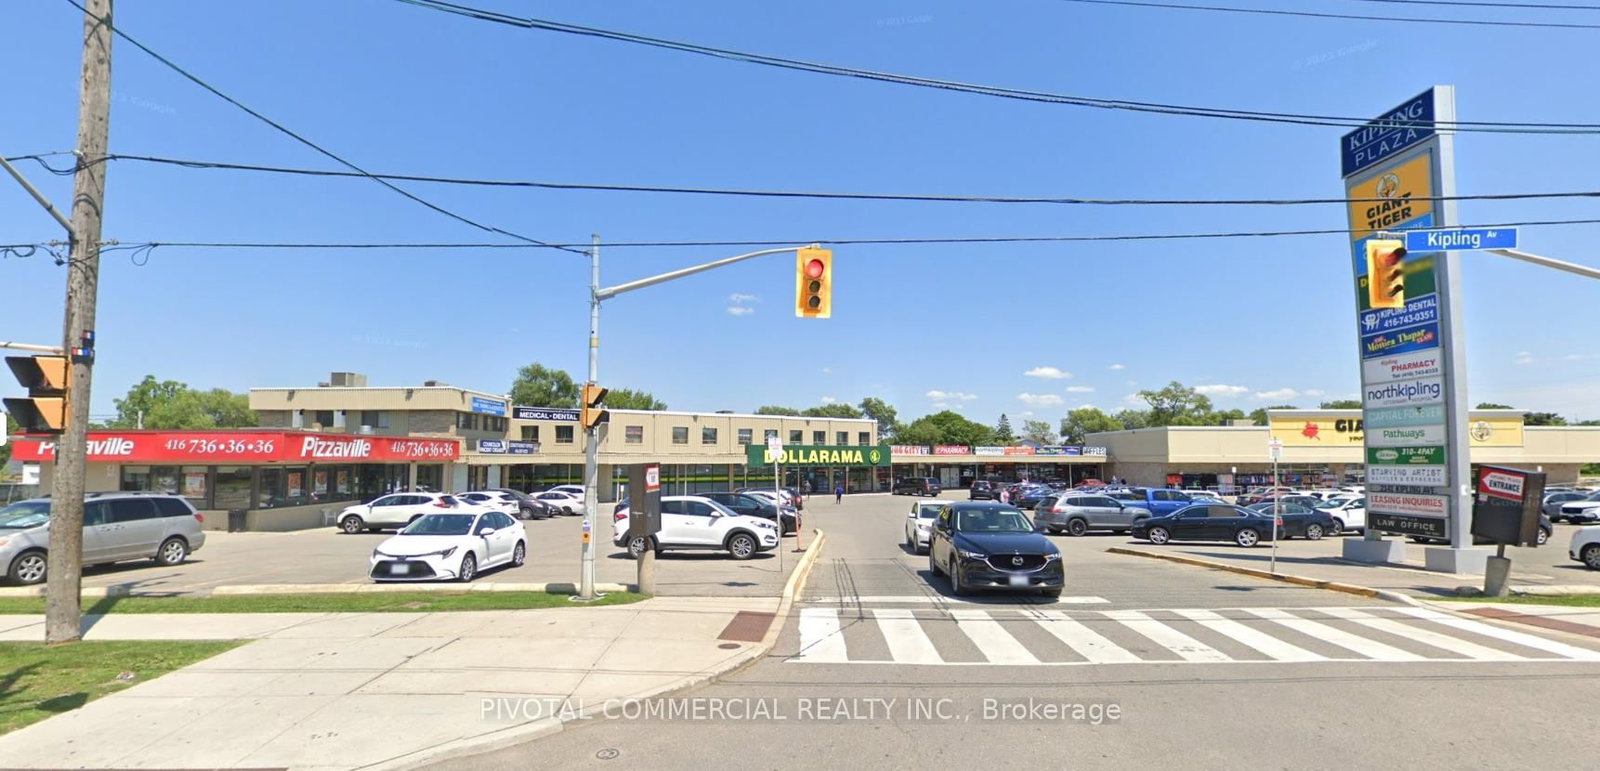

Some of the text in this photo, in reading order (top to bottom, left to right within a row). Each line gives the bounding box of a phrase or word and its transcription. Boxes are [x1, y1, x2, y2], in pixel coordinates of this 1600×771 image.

[1350, 100, 1423, 150] KIPLING
[1355, 128, 1417, 166] PLAZA
[1366, 191, 1412, 219] GIANT
[1367, 206, 1412, 229] TIGER
[1428, 231, 1497, 249] Kipling Av
[1408, 299, 1436, 312] DENTAL
[1384, 310, 1434, 328] 416-743-0351
[1391, 359, 1436, 372] PHARMACY
[1367, 380, 1441, 401] northkipling
[1383, 428, 1426, 439] Pathways
[165, 439, 186, 450] 416
[301, 436, 372, 458] Pizzaville
[391, 442, 405, 453] 416
[940, 446, 969, 455] PHARMACY
[764, 449, 864, 464] DOLLARAMA
[1371, 468, 1442, 477] STARVING ARTIST
[1488, 480, 1522, 493] ENTRANCE
[1370, 495, 1443, 508] LEASING INQUIRIES
[1376, 519, 1436, 531] LAW OFFICE
